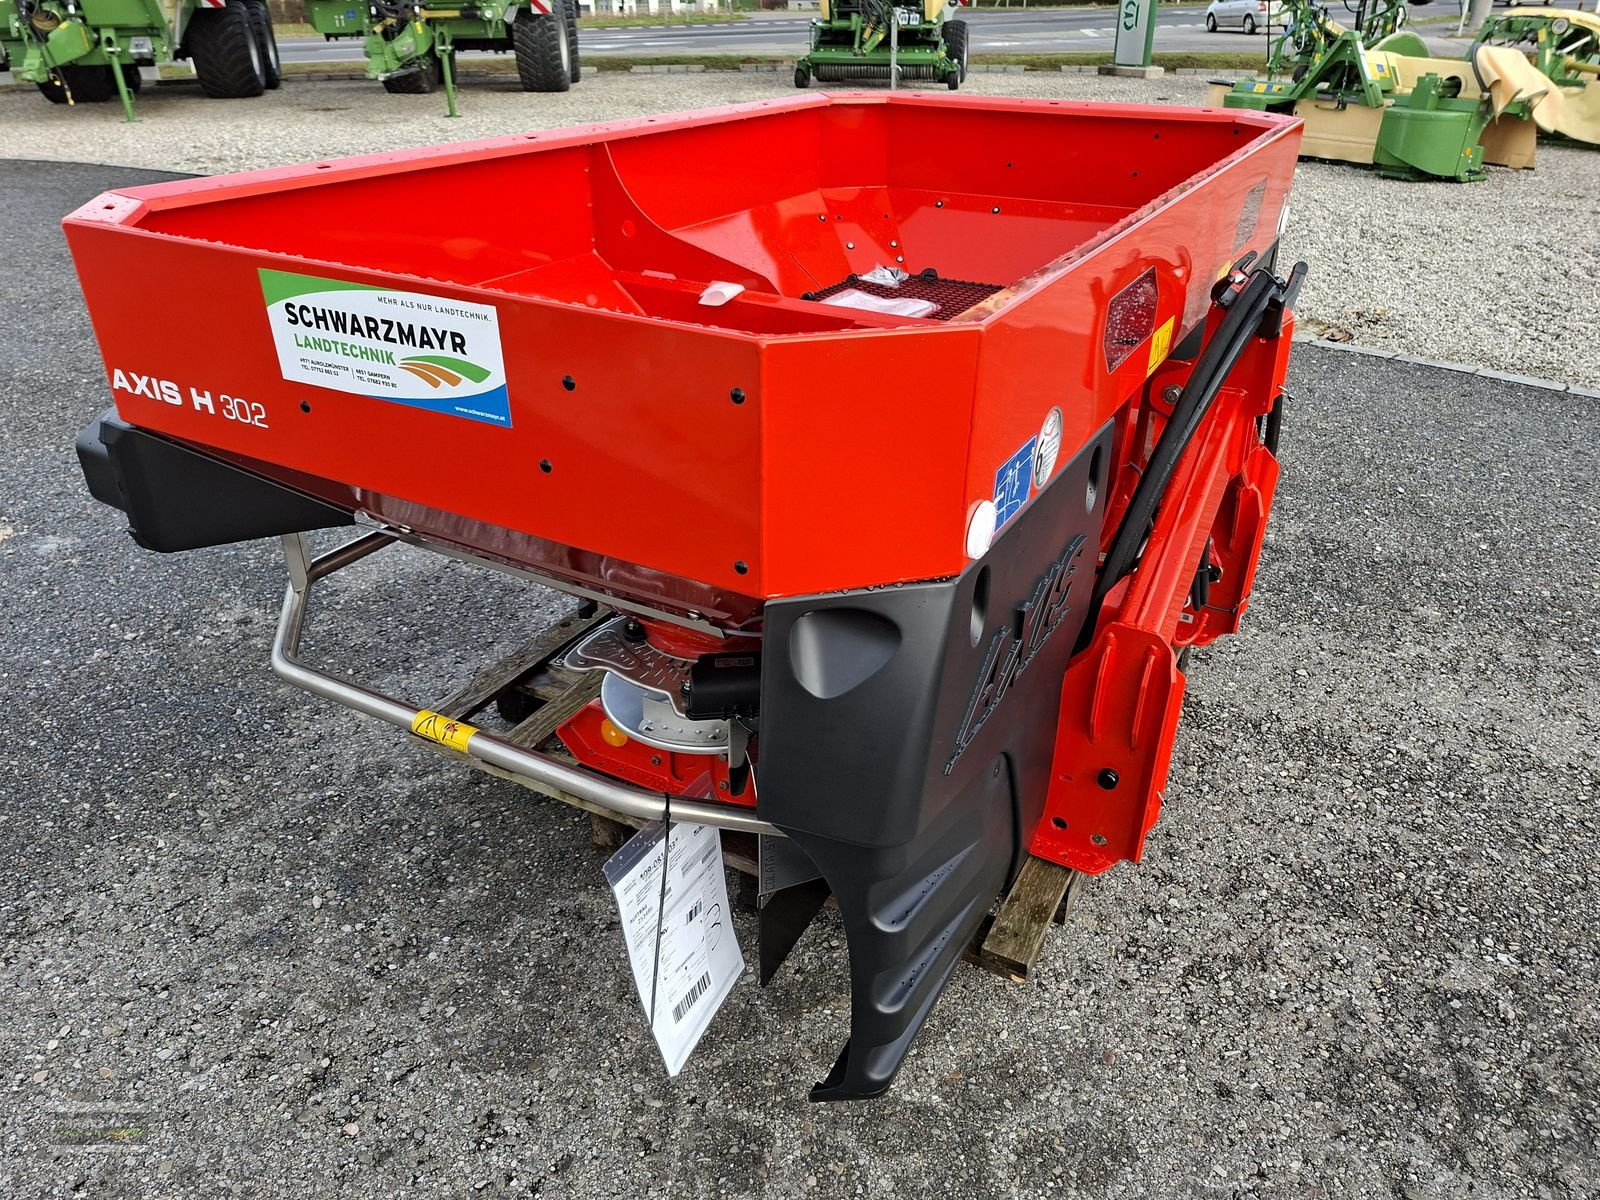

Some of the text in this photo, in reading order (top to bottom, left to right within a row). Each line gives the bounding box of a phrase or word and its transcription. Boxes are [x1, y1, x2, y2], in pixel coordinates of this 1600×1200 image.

[284, 302, 467, 356] SCHWARZMAYR
[377, 296, 492, 321] MEHR ALS NUR LANDTECHNIK.
[294, 333, 397, 366] LANDTECHNIK
[113, 368, 269, 428] AXIS H 30.2
